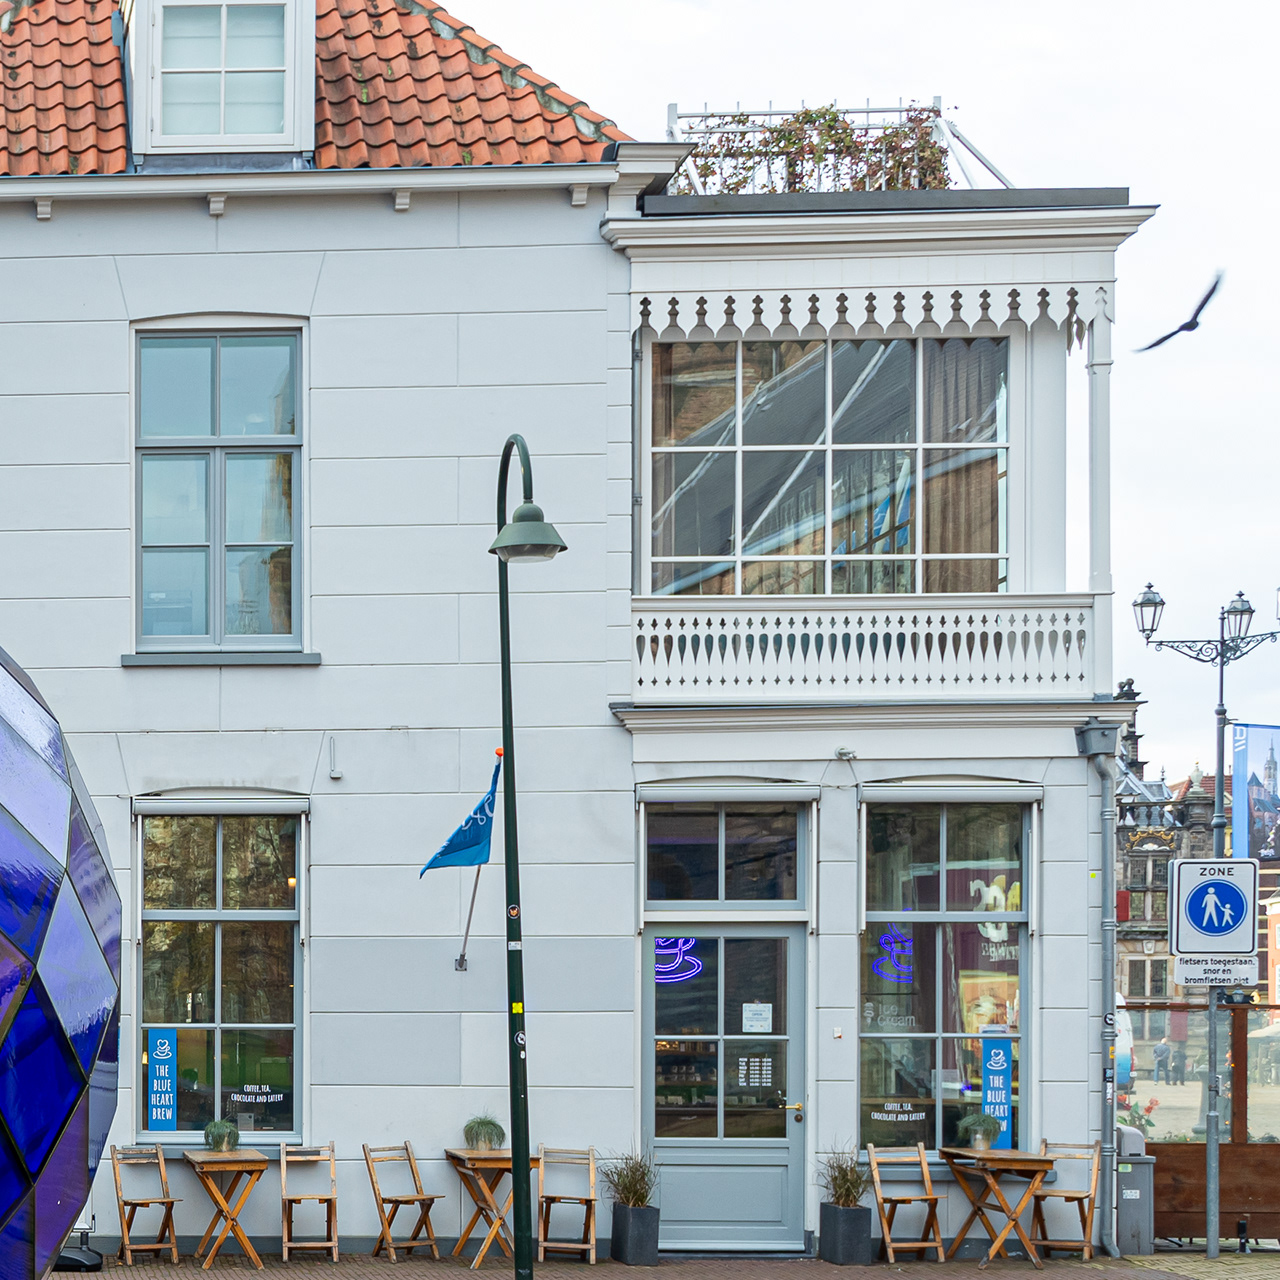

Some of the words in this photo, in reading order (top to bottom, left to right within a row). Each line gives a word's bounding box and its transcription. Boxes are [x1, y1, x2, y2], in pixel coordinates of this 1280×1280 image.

[1199, 867, 1234, 876] ZONE
[1179, 957, 1209, 966] fietsers
[1184, 976, 1232, 984] bromfietsen
[878, 1003, 898, 1015] Ice
[877, 1015, 916, 1026] Cream
[155, 1065, 170, 1077] THE
[153, 1079, 172, 1092] BLUE
[989, 1075, 1004, 1088] THE
[151, 1093, 174, 1106] HEART
[230, 1093, 255, 1103] CHOCOLATE
[256, 1095, 267, 1103] AND
[987, 1090, 1007, 1103] BLUE
[152, 1107, 173, 1120] BREW
[984, 1104, 1009, 1117] HEART
[897, 1113, 909, 1121] AND
